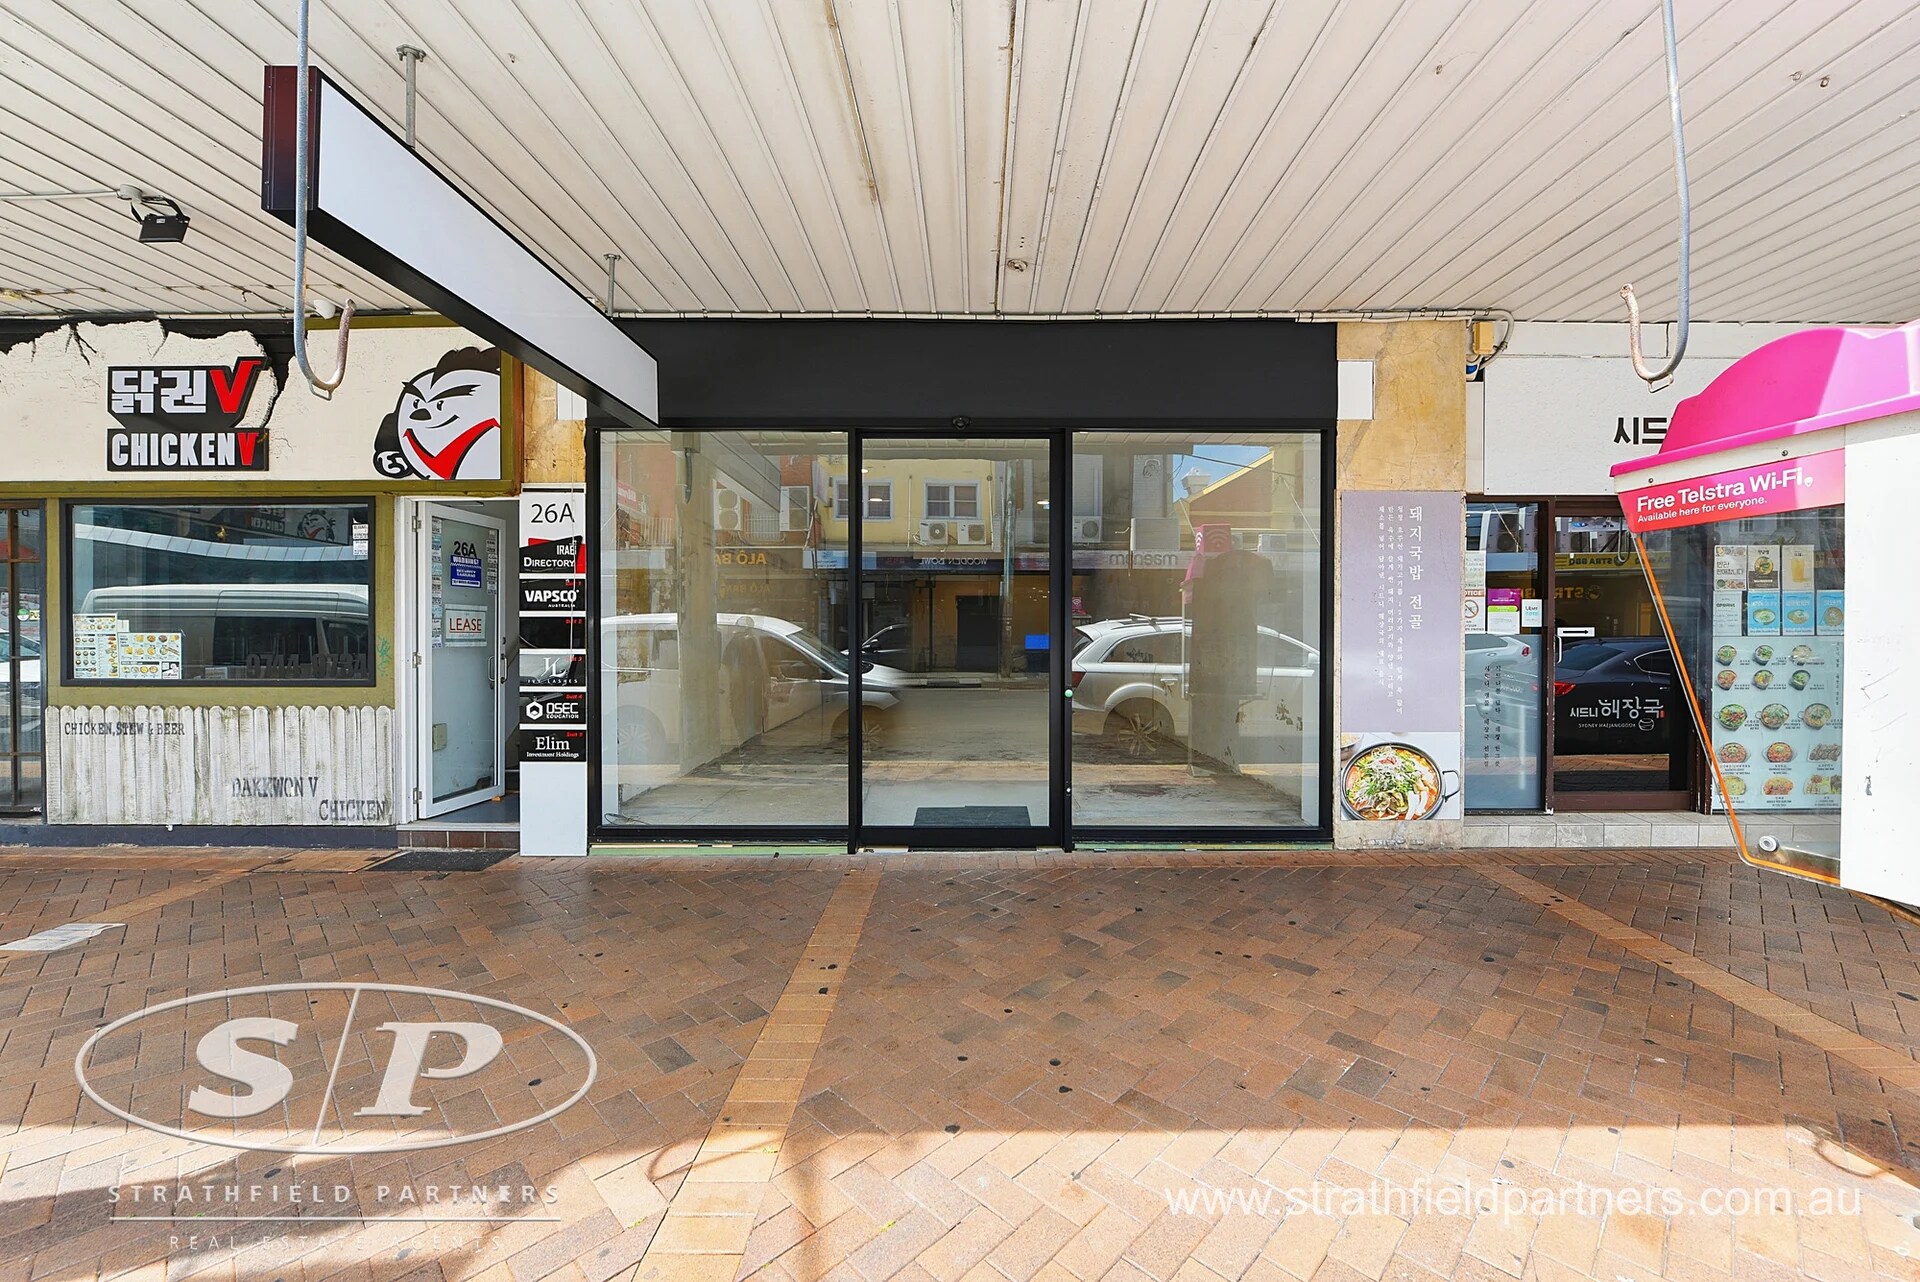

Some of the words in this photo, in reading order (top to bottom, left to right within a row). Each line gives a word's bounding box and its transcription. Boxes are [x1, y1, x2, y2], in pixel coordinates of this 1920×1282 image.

[1637, 494, 1675, 513] Free
[1677, 481, 1746, 505] Telstra
[1750, 467, 1803, 493] Wi-Fi
[530, 503, 575, 524] 26A
[1637, 510, 1677, 523] Available
[1679, 506, 1700, 517] here
[1702, 504, 1716, 513] for
[1718, 496, 1767, 511] everyone.
[453, 541, 477, 558] 26A
[1408, 505, 1424, 581] 돼지국밥
[1408, 594, 1423, 629] 전골
[449, 618, 482, 632] LEASE
[1569, 707, 1598, 718] 시드니
[1598, 696, 1664, 719] 해장국
[147, 723, 154, 735] &
[156, 722, 185, 736] BEER
[535, 735, 570, 750] Elim
[306, 776, 319, 796] V
[319, 799, 386, 822] CHICKEN
